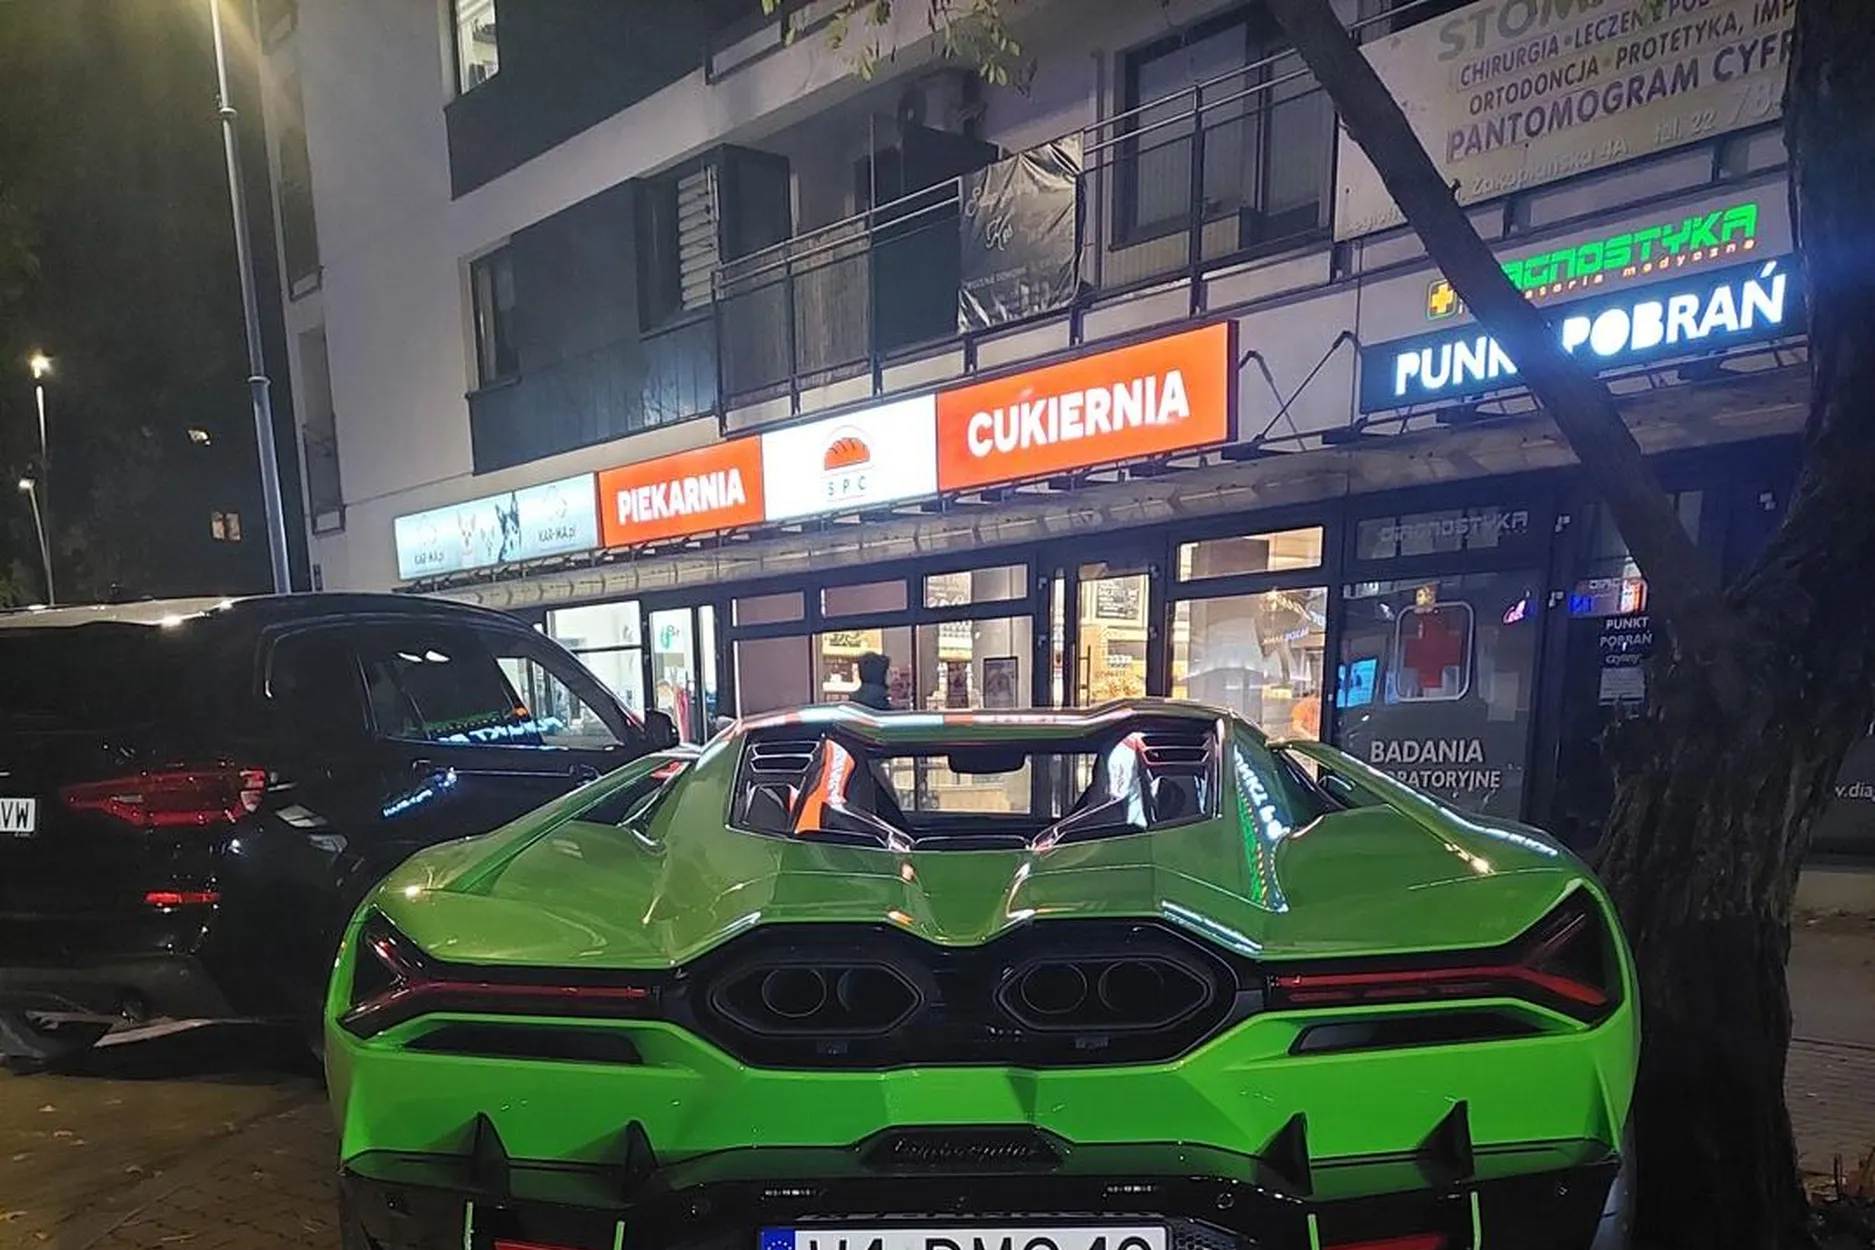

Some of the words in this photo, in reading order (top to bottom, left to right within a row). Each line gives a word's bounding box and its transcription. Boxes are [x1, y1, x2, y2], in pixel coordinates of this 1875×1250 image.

[1460, 35, 1559, 86] CHIRURGIA
[1469, 55, 1599, 115] ORTODONCJA
[1616, 11, 1744, 69] PROTETYKA,
[1449, 58, 1700, 153] PANTOMOGRAM
[1563, 261, 1786, 355] POBRAŃ
[967, 369, 1190, 457] CUKIERNIA
[617, 468, 745, 525] PIEKARNIA
[1606, 616, 1649, 630] PUNKT
[1370, 739, 1485, 763] BADANIA
